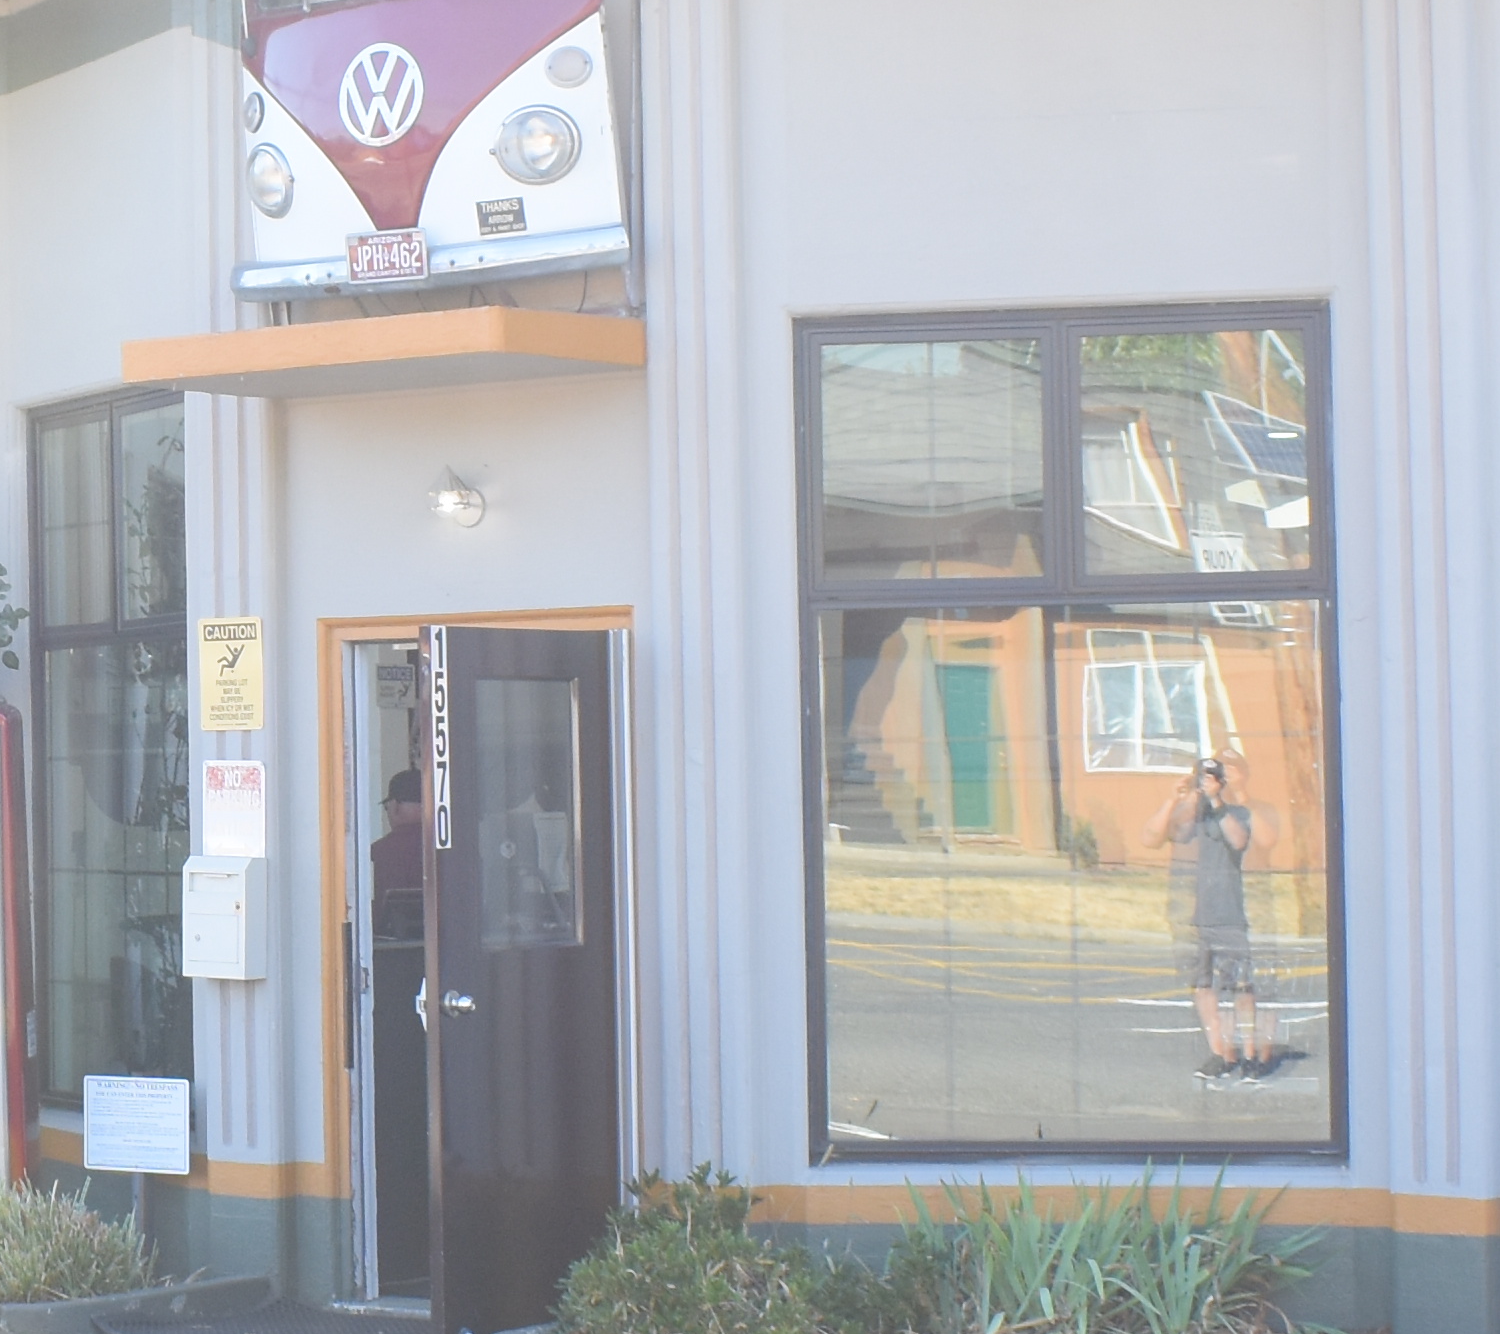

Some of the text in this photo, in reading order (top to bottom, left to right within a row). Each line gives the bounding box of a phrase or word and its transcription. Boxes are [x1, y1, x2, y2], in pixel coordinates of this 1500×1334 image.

[480, 199, 519, 214] THANKS
[368, 235, 403, 244] ARIZONA
[205, 624, 256, 640] CAUTION
[434, 627, 450, 848] 15570
[224, 770, 241, 787] NO
